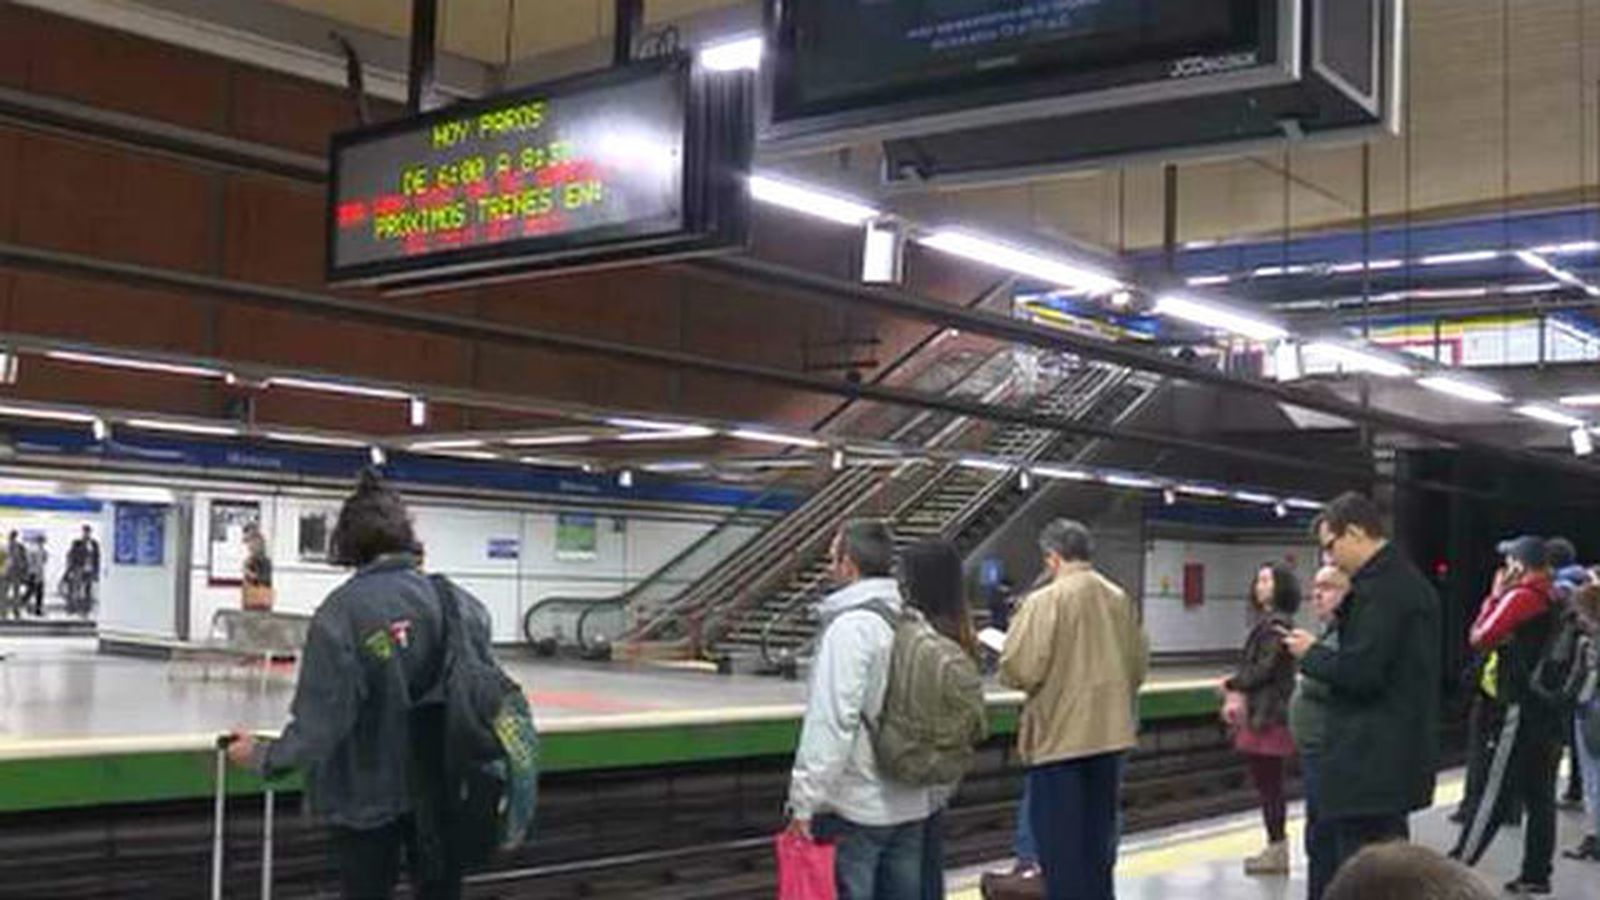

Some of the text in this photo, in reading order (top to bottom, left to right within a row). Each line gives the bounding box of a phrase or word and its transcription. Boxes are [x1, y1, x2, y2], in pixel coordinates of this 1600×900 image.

[480, 102, 544, 138] PAROS
[403, 168, 428, 196] DE
[436, 156, 484, 190] 6:00
[374, 202, 466, 240] PROXIMOS
[478, 186, 553, 222] TRENES
